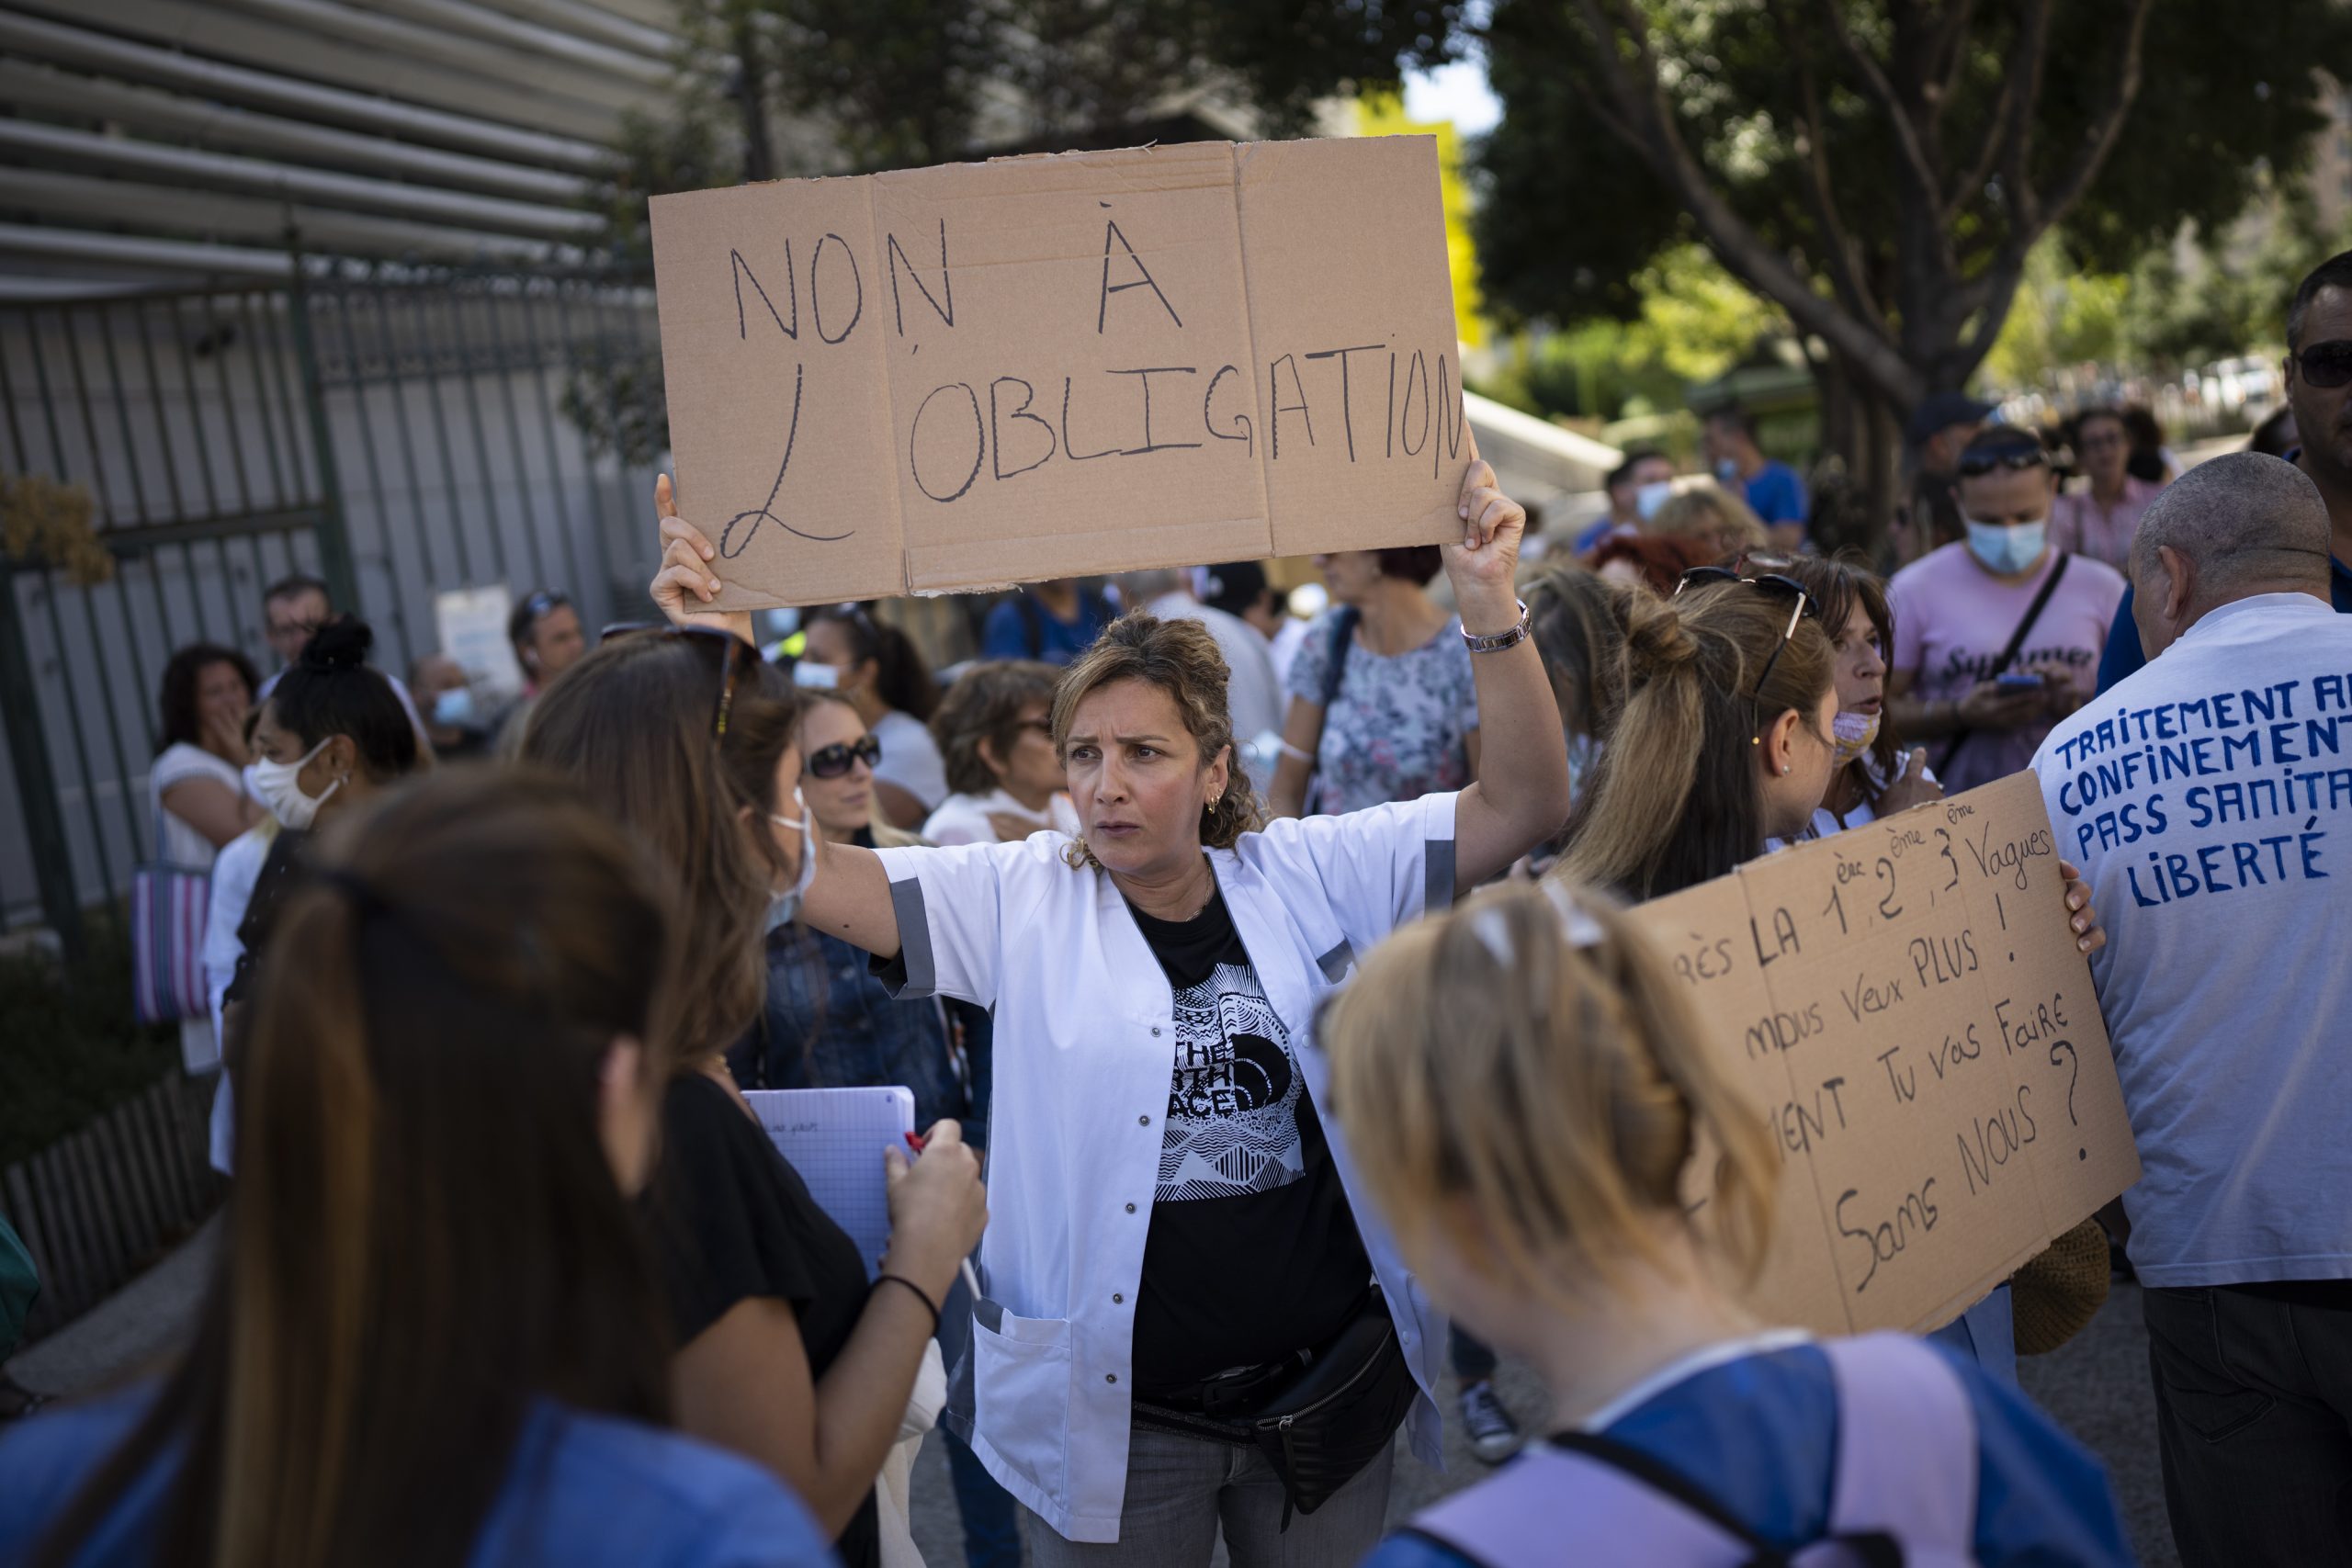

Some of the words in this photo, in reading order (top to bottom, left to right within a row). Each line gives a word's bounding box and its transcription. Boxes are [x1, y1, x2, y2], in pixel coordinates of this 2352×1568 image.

[729, 217, 954, 344] NON
[1099, 200, 1182, 333] À
[2076, 794, 2168, 862] PASS
[1750, 906, 1801, 967] LA
[1964, 820, 2052, 890] Vagues
[1908, 929, 1979, 988] PLUS
[1957, 1084, 2036, 1196] NOUS
